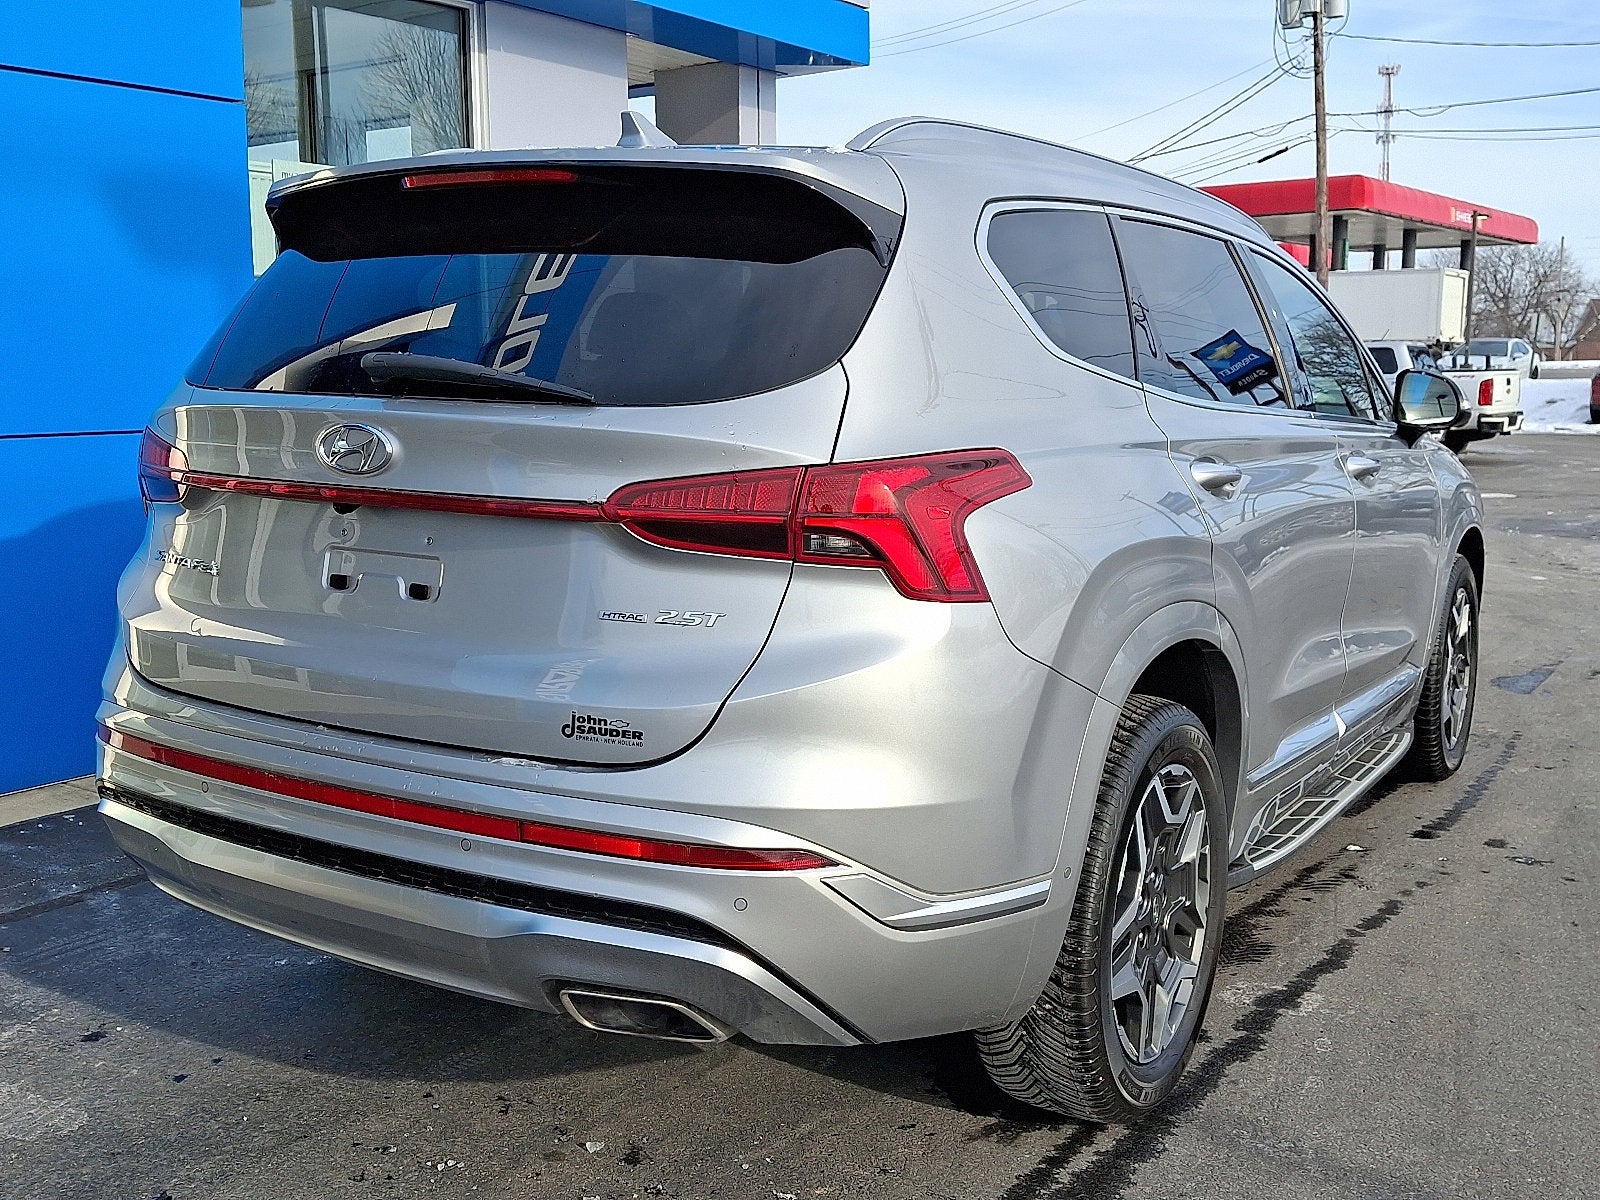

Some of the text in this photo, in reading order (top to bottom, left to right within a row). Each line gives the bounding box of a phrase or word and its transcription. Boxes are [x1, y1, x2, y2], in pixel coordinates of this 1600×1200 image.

[155, 549, 191, 569] SANTA
[601, 611, 645, 622] HTRAC
[575, 724, 644, 741] SAUDER
[575, 735, 600, 743] EPHRATA
[617, 740, 644, 748] HOLLAND
